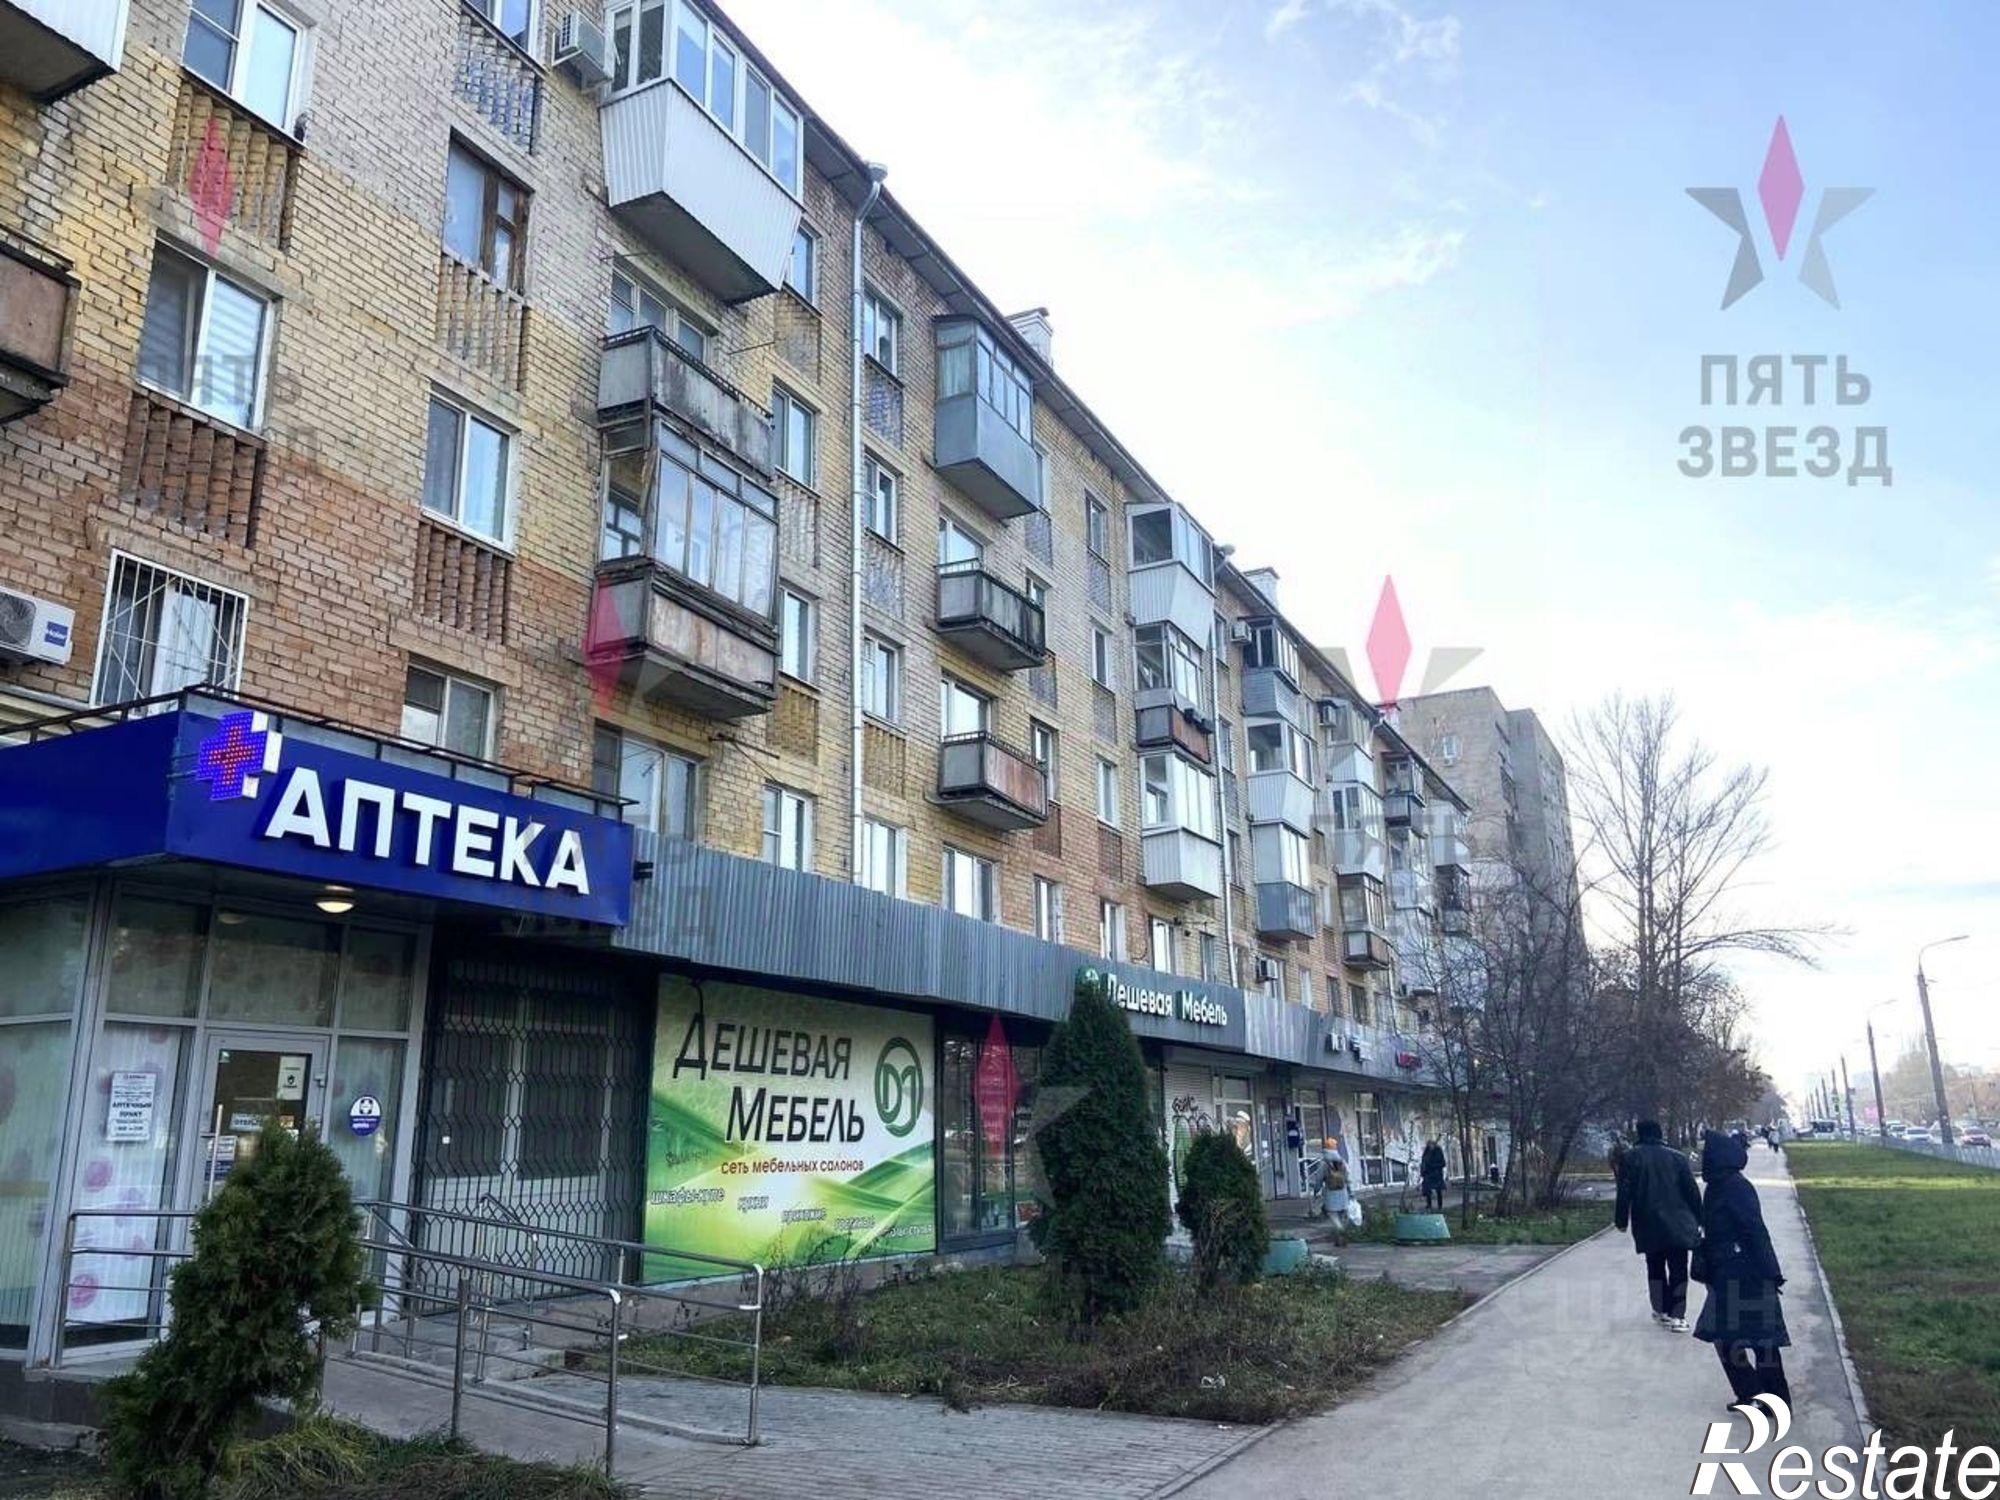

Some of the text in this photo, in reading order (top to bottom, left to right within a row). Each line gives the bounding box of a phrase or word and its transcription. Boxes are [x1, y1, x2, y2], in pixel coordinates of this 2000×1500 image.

[265, 766, 590, 895] АПТЕКА
[1181, 989, 1228, 1027] Мебель
[672, 1013, 852, 1080] ДЕШЕВАЯ
[725, 1086, 865, 1144] МЕБЕЛЬ
[752, 1156, 818, 1174] мебельных
[820, 1159, 865, 1172] салонов
